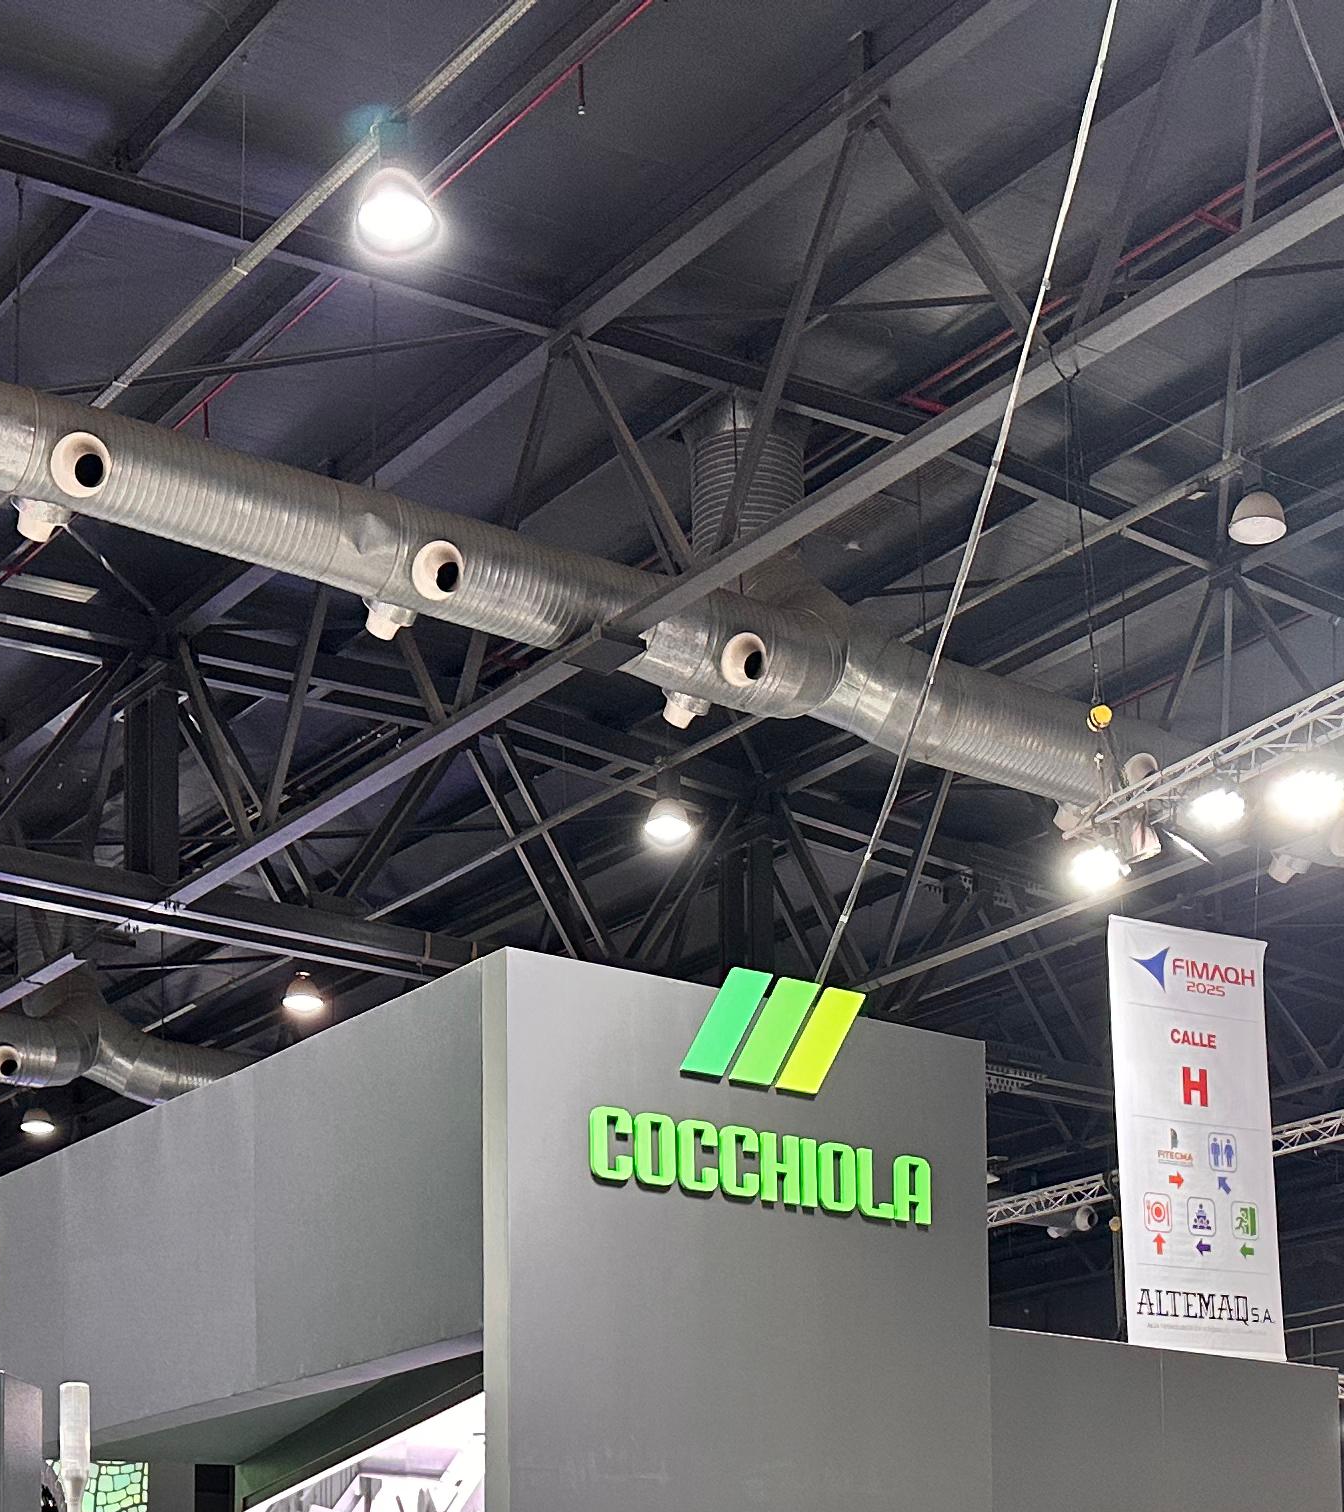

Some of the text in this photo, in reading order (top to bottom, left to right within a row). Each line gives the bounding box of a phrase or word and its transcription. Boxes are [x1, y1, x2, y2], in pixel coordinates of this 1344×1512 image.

[1172, 958, 1255, 987] FIMAQH
[1186, 981, 1226, 997] 2025
[1170, 1028, 1217, 1049] CALLE
[1182, 1066, 1209, 1107] H
[589, 1105, 932, 1225] COCCHIOLA
[1136, 1288, 1250, 1326] ALTEMAQ
